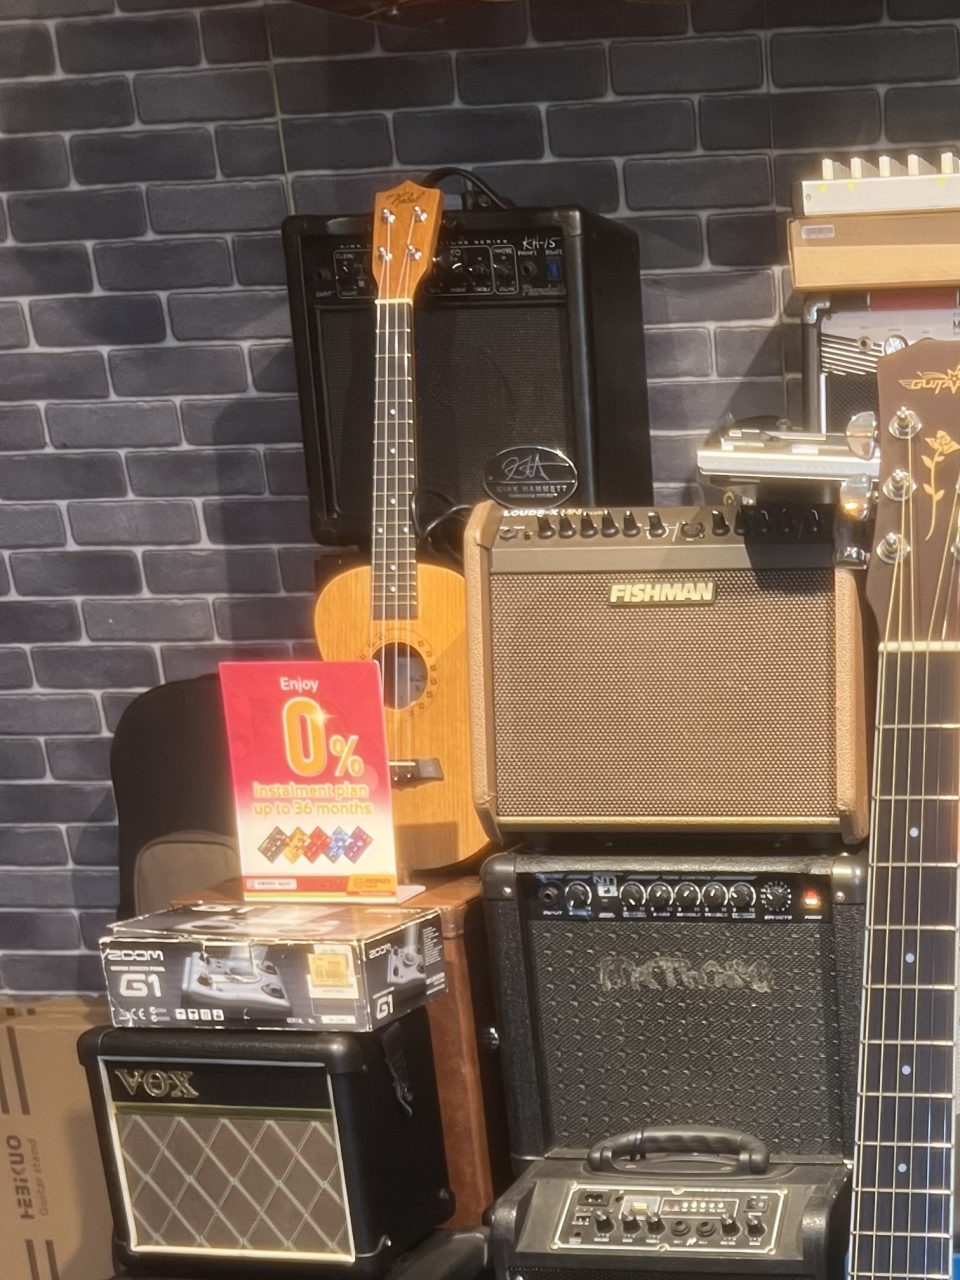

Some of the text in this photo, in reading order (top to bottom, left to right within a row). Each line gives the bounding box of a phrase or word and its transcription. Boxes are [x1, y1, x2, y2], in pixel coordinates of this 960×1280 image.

[609, 582, 714, 603] FISHMAN
[279, 677, 319, 693] Enjoy
[253, 781, 369, 800] Instalment plan
[254, 801, 372, 816] up to 36 months
[107, 950, 164, 961] ZOOM
[119, 973, 162, 998] G1
[376, 994, 394, 1020] G1
[114, 1069, 199, 1098] VOX
